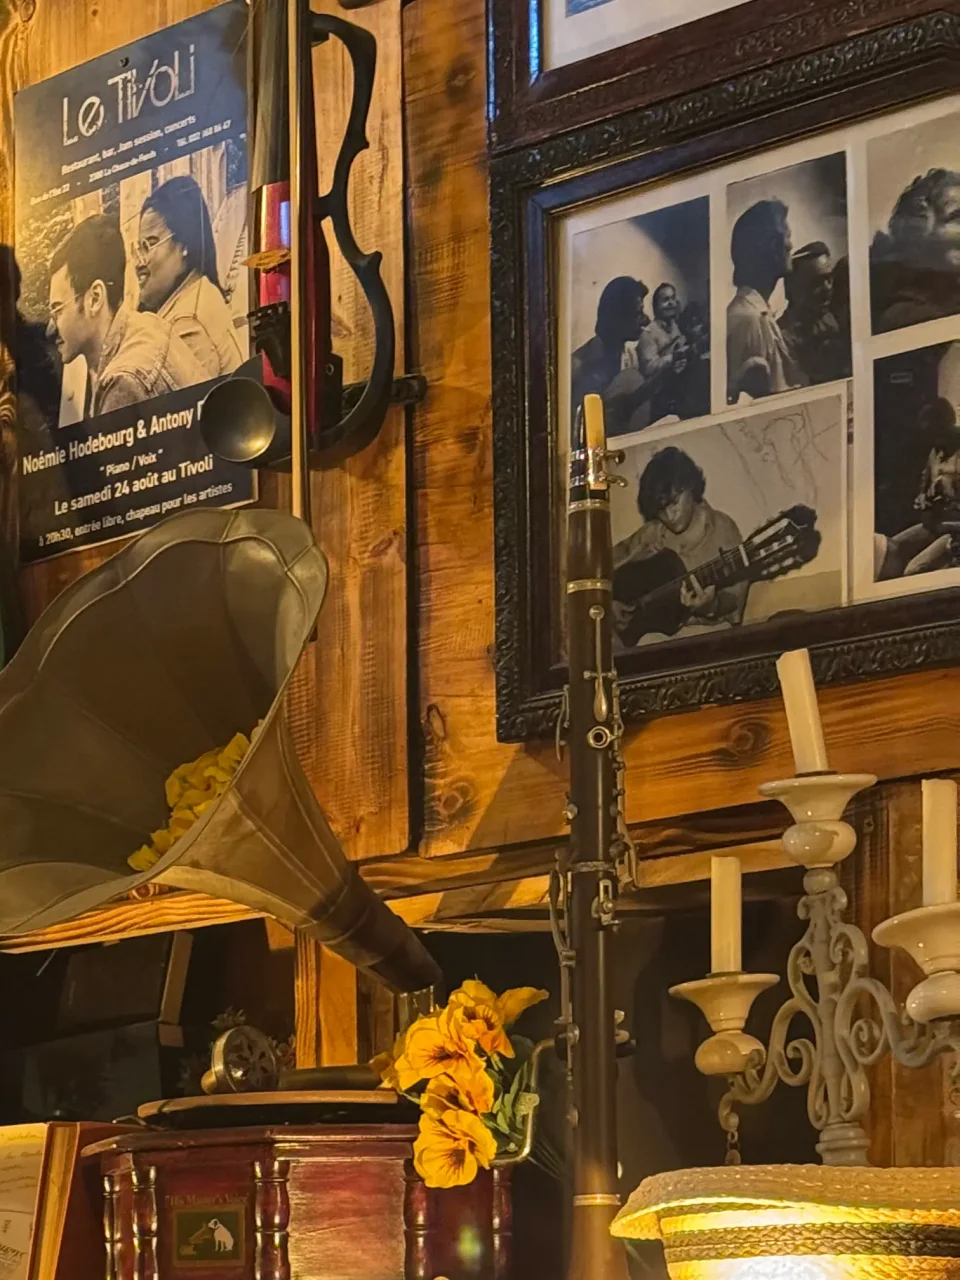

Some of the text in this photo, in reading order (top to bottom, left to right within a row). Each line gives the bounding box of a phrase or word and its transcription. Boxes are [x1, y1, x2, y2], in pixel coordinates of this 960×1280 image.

[23, 447, 66, 475] Noémie
[69, 424, 134, 460] Hodebourg
[136, 418, 147, 439] &
[149, 406, 195, 436] Antony
[54, 454, 214, 516] Le samedi 24 août au Tivoli
[74, 519, 101, 537] entrée
[125, 502, 161, 523] chapeau
[161, 498, 182, 512] pour
[183, 492, 198, 504] les
[198, 482, 233, 501] artistes
